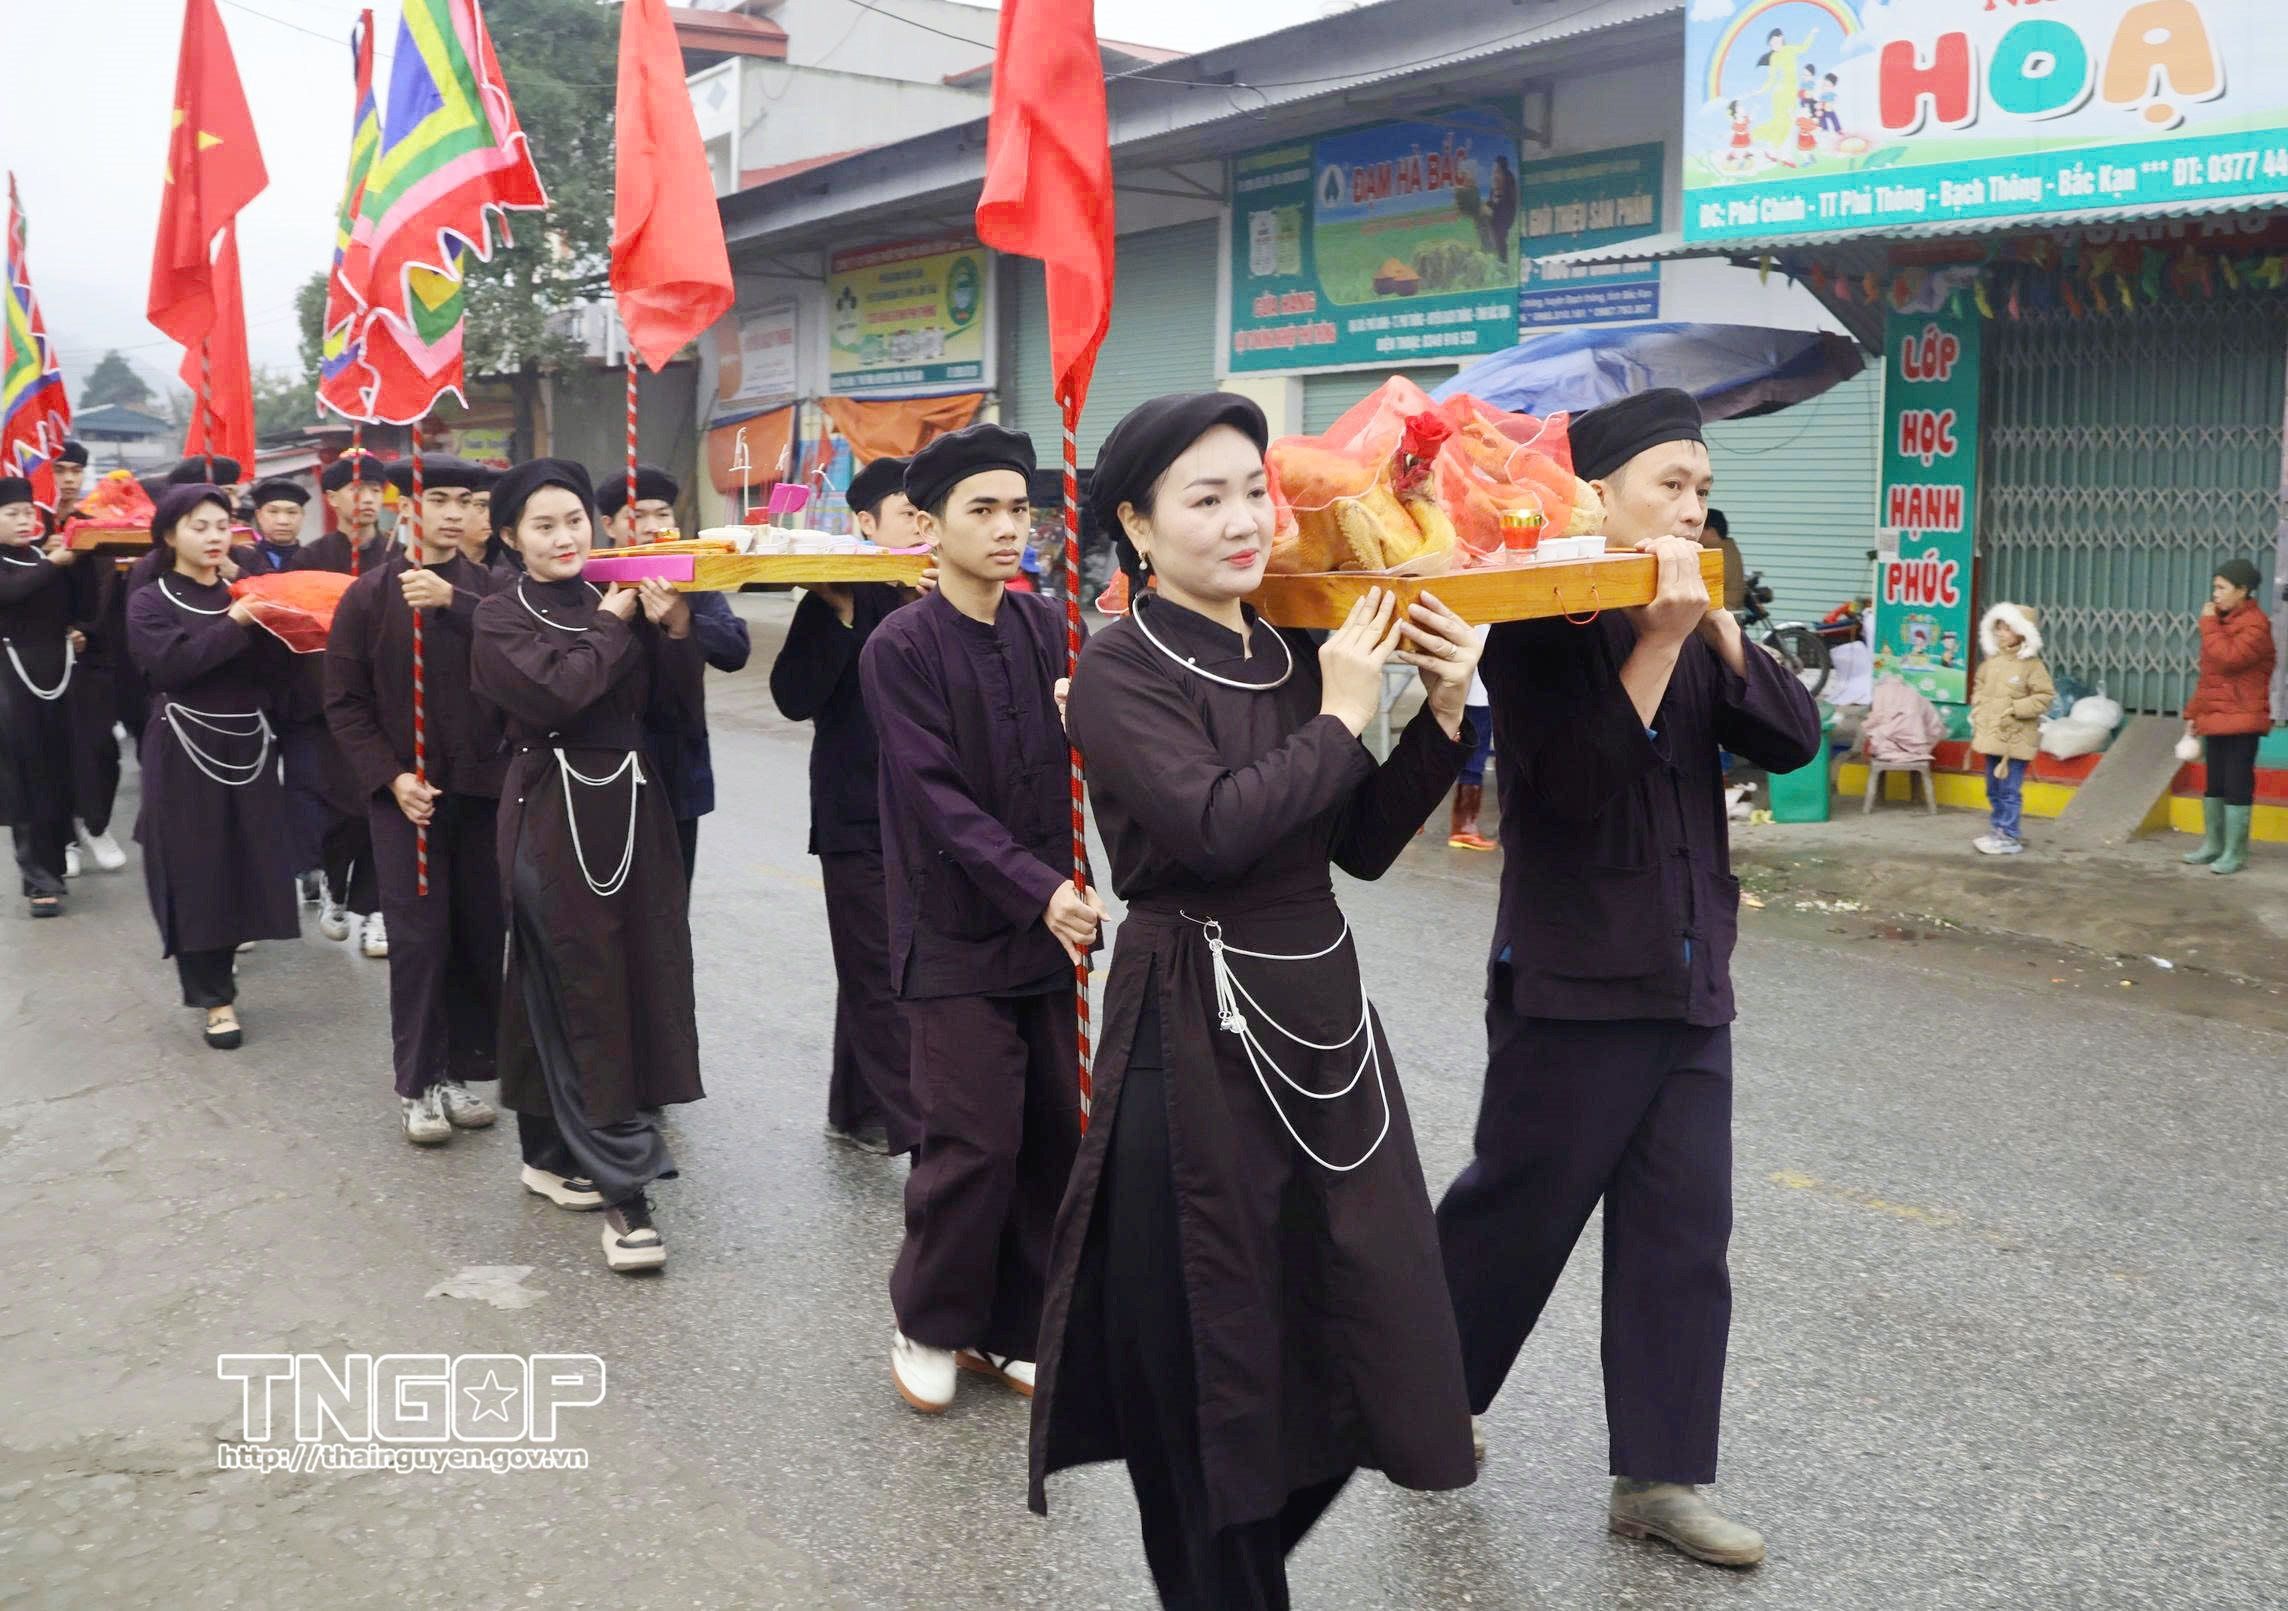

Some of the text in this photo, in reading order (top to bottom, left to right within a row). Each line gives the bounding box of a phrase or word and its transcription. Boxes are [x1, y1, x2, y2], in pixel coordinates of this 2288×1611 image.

[1395, 144, 1423, 194] HÀ
[1818, 192, 1838, 217] TT
[1940, 178, 1985, 212] Bạch
[1988, 173, 2042, 203] Thông
[2058, 161, 2095, 197] Bắc
[2098, 165, 2136, 198] Kạn
[2207, 151, 2259, 183] 0377
[1902, 323, 1960, 382] LỚP
[1899, 409, 1957, 467] HỌC
[1887, 485, 1964, 541] HẠNH
[1884, 548, 1958, 607] PHÚC
